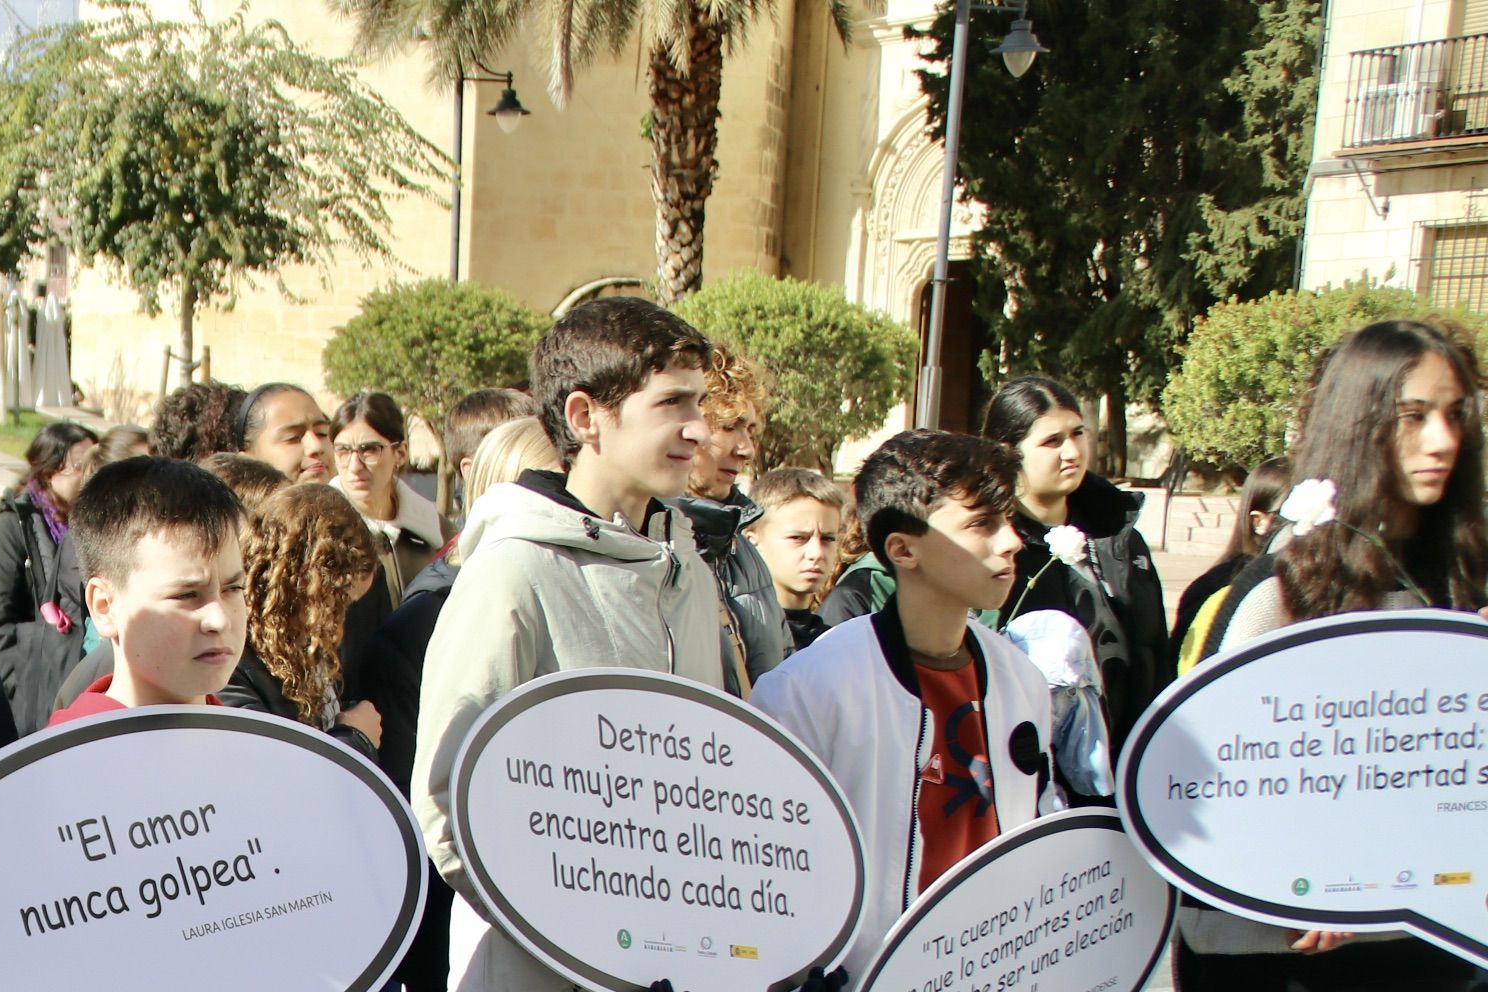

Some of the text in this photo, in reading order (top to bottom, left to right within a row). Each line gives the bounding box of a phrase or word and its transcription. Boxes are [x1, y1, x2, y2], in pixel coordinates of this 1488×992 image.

[1315, 688, 1427, 728] igualdad
[1437, 693, 1469, 713] es
[1478, 693, 1488, 711] e
[598, 714, 733, 767] Detrás de
[1218, 722, 1484, 761] alma de la libertad;
[507, 757, 810, 825] una mujer poderosa se
[1168, 759, 1488, 800] hecho no hay libertad s
[129, 804, 215, 849] amor
[529, 811, 810, 872] encuentra ella misma
[20, 886, 129, 936] nunca
[552, 852, 794, 917] luchando cada día.
[960, 906, 1018, 947] cuerpo
[1024, 897, 1034, 922] y
[1040, 885, 1053, 907] la
[1060, 861, 1111, 898] forma
[182, 891, 333, 941] LAURA IGLESIA SAN MARTÍN
[960, 957, 974, 980] lo
[981, 910, 1070, 969] compartes
[1076, 895, 1104, 921] con
[1110, 877, 1125, 904] el
[997, 965, 1025, 992] ser
[1031, 949, 1059, 975] una
[1065, 909, 1133, 957] elección
